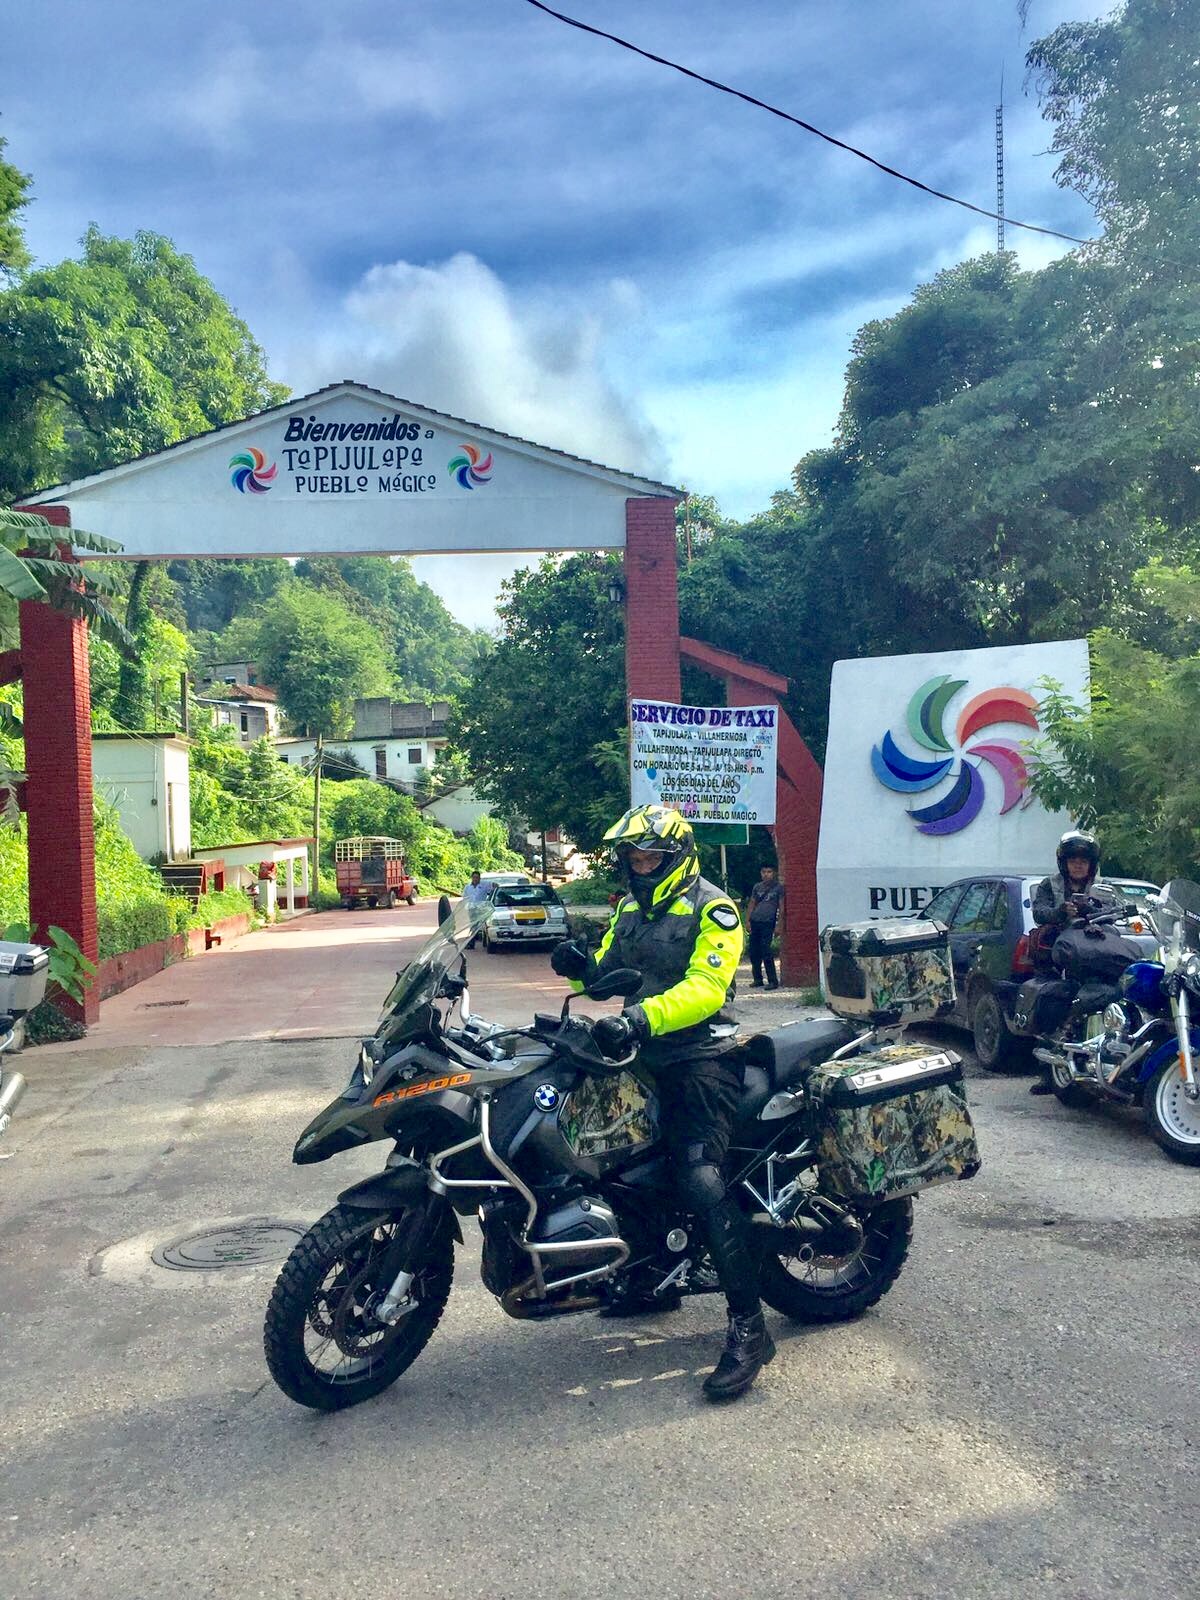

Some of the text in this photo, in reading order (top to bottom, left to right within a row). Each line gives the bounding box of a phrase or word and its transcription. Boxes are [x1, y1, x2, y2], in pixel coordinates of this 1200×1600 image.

[284, 414, 435, 442] Bienvenidos a
[632, 704, 775, 728] SERVICIO DE TAXI
[653, 729, 692, 740] TAPIJULAPA
[698, 731, 748, 742] VILLAHERMOSA
[637, 744, 688, 756] VILLAHERMOSA
[693, 746, 732, 757] TAPIJULAPA
[633, 760, 648, 769] CON
[649, 760, 679, 771] HORARIO
[680, 762, 690, 771] DE
[662, 777, 676, 786] LOS
[707, 779, 720, 788] DEL
[660, 792, 736, 805] SERVICIO CLIMATIZADO
[703, 810, 730, 820] PUEBLO
[731, 811, 758, 821] MAGICO
